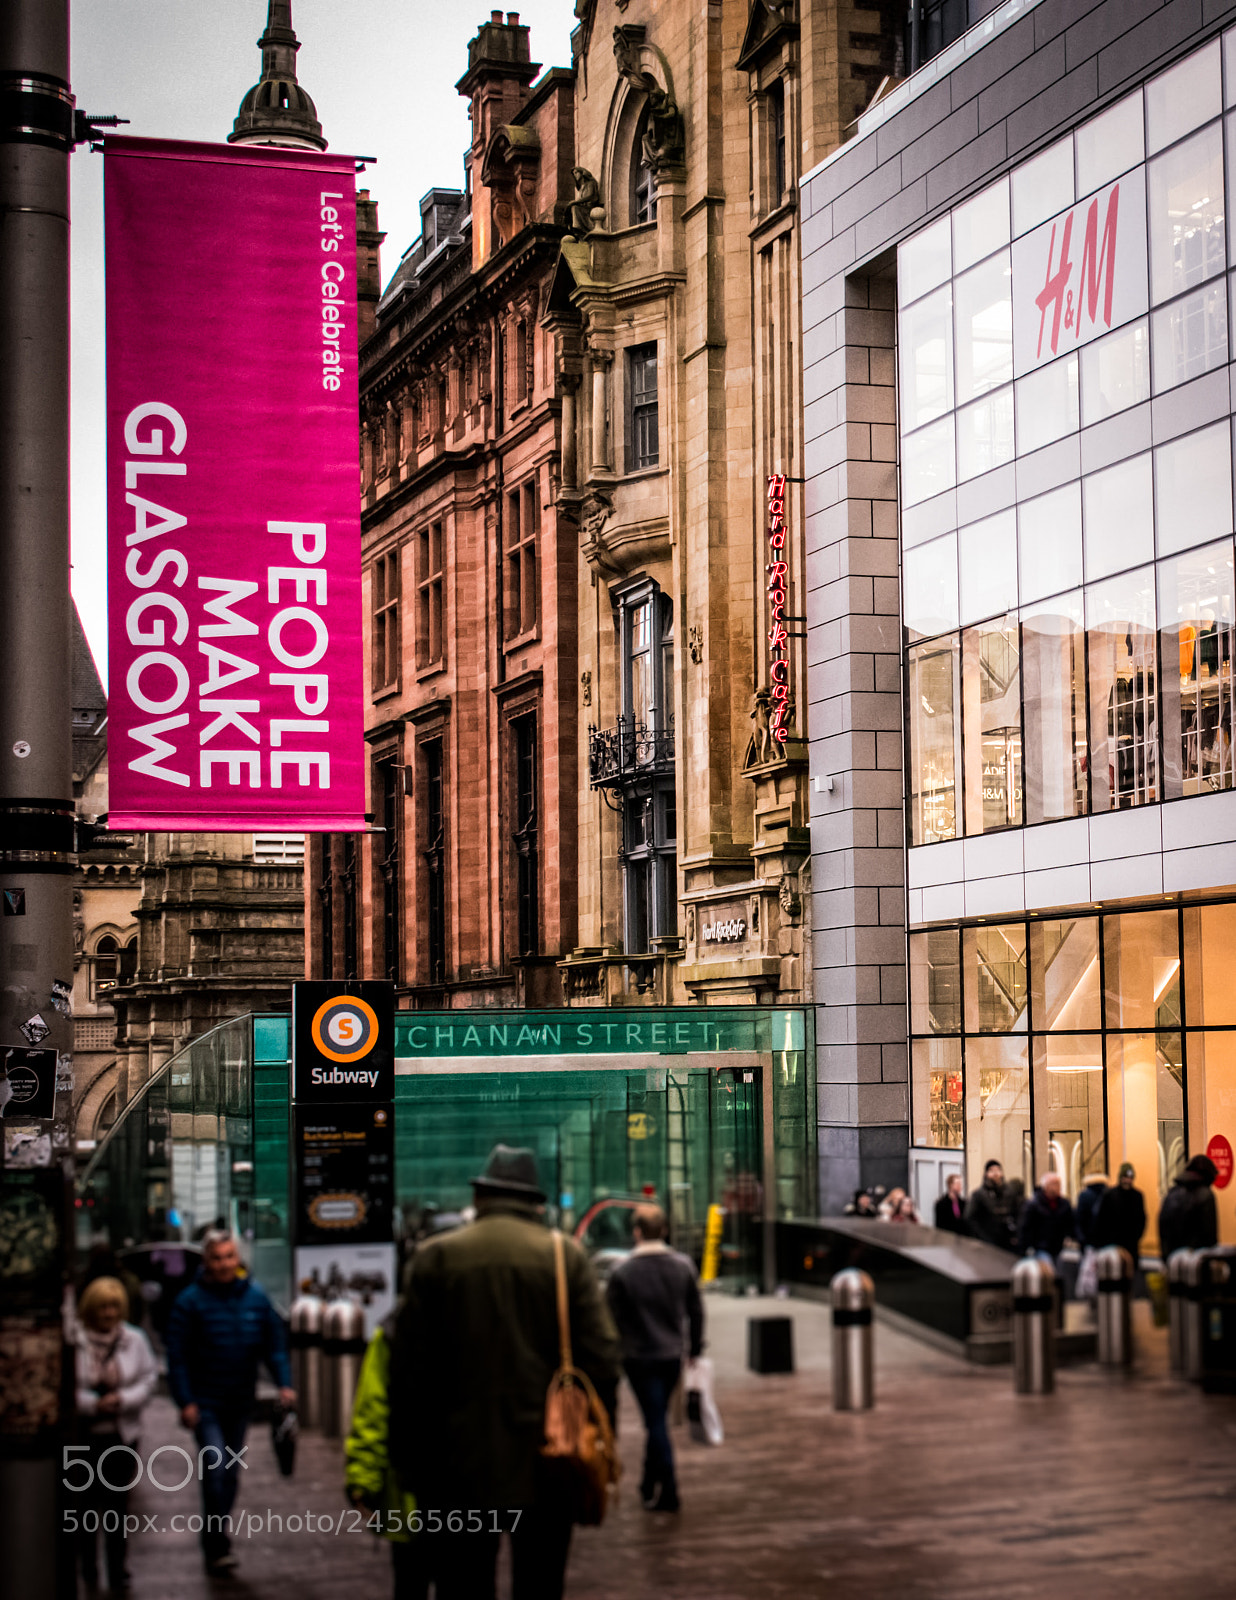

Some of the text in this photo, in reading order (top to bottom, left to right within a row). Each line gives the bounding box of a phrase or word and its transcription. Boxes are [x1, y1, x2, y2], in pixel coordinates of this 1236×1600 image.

[321, 261, 345, 391] Celebrate
[1035, 183, 1119, 360] H&M
[124, 401, 190, 788] GLASGOW
[198, 576, 261, 788] MAKE
[267, 520, 330, 789] PEOPLE
[766, 474, 789, 743] Hard Rock Cafe
[311, 1066, 379, 1088] Subway
[338, 1018, 353, 1039] S
[394, 1022, 715, 1048] CHANAN STREET
